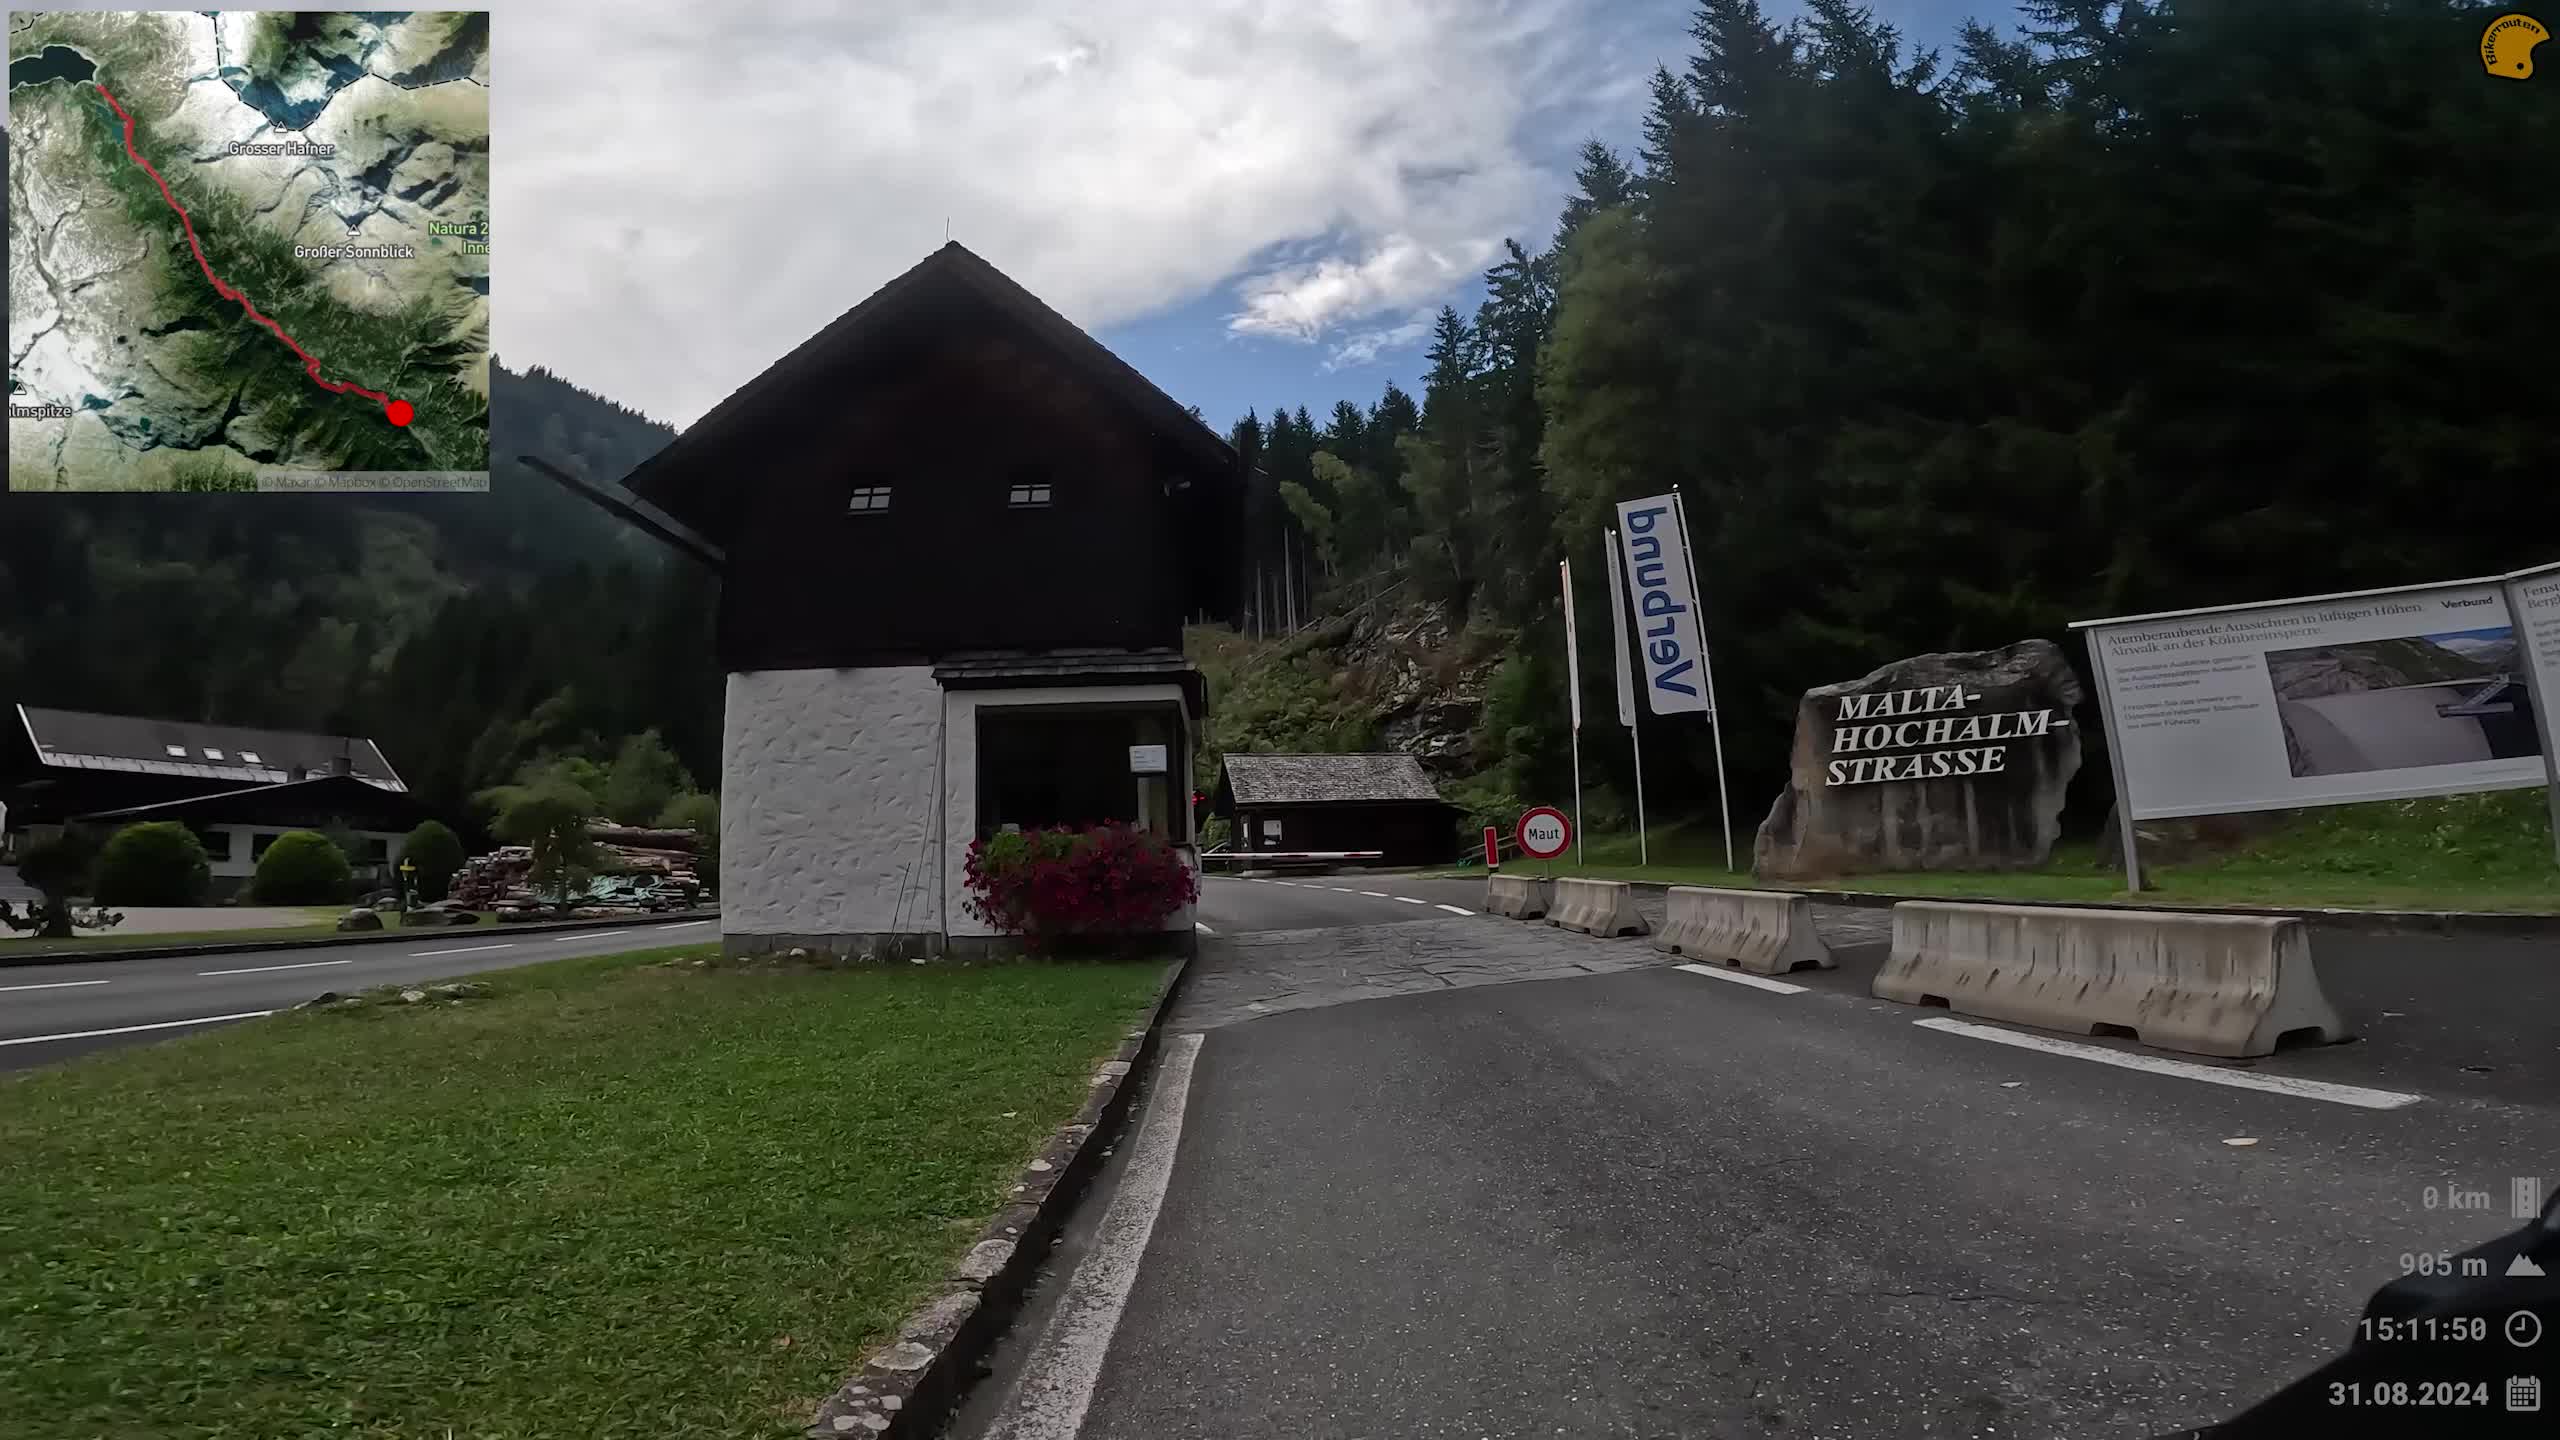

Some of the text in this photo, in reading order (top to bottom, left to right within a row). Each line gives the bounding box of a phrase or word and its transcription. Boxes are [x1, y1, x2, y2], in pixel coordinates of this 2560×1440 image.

[2441, 596, 2493, 609] Verbund
[2108, 626, 2223, 646] Atemberaubende
[2225, 616, 2300, 633] Aussichten
[2302, 614, 2315, 624] in
[2319, 608, 2372, 623] luftigen
[2111, 642, 2160, 657] Airwalk
[2163, 643, 2180, 652] an
[2183, 637, 2206, 649] der
[1835, 684, 1981, 721] MALTA-
[1832, 709, 2070, 753] HOCHALM-
[1825, 746, 2006, 787] STRASSE
[1529, 827, 1560, 841] Maut
